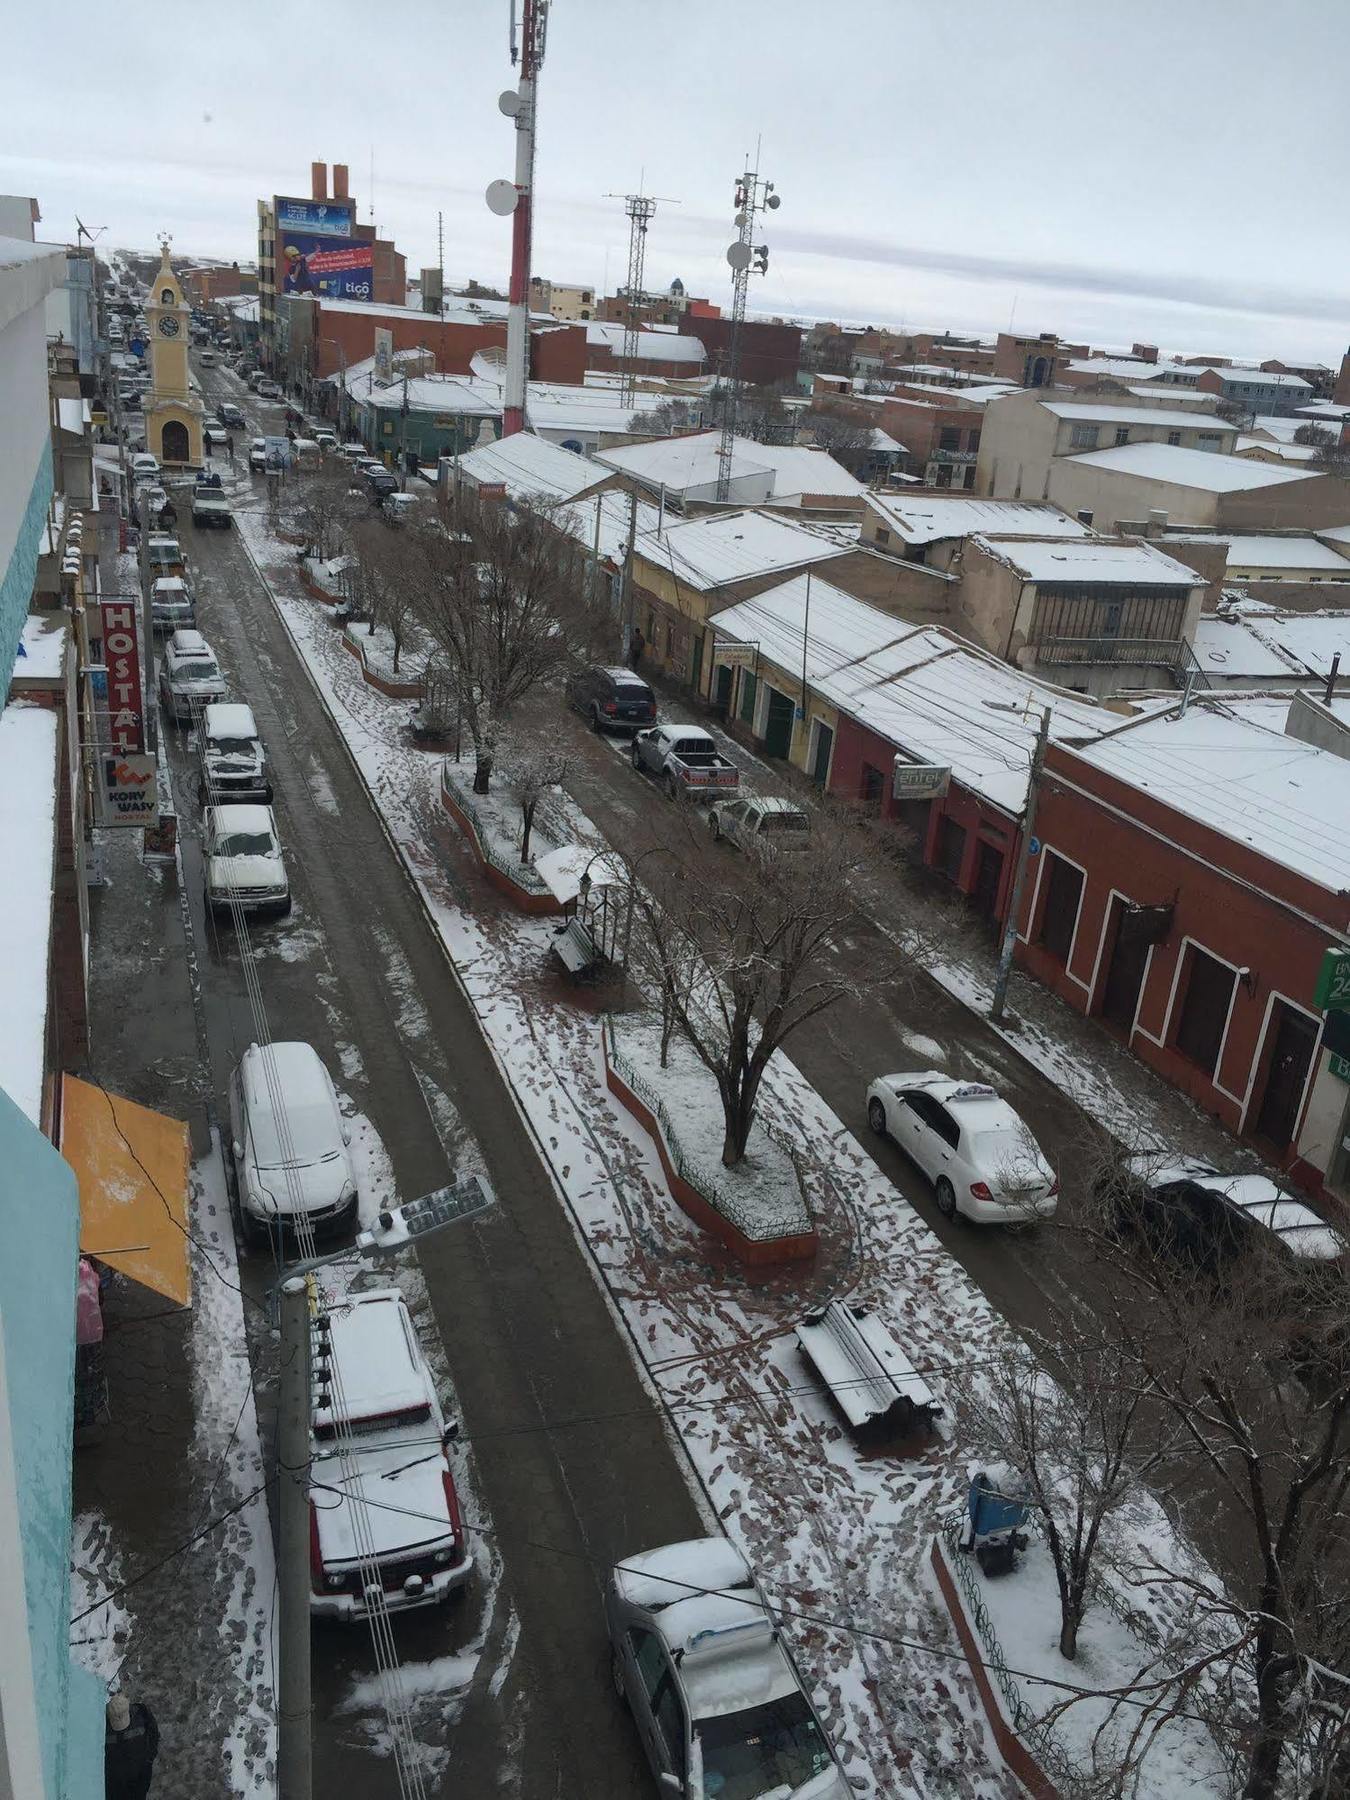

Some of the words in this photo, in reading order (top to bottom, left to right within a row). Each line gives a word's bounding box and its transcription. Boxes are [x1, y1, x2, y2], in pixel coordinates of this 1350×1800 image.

[105, 607, 138, 751] HOSTAL
[900, 772, 938, 786] entel
[117, 801, 155, 813] WASY
